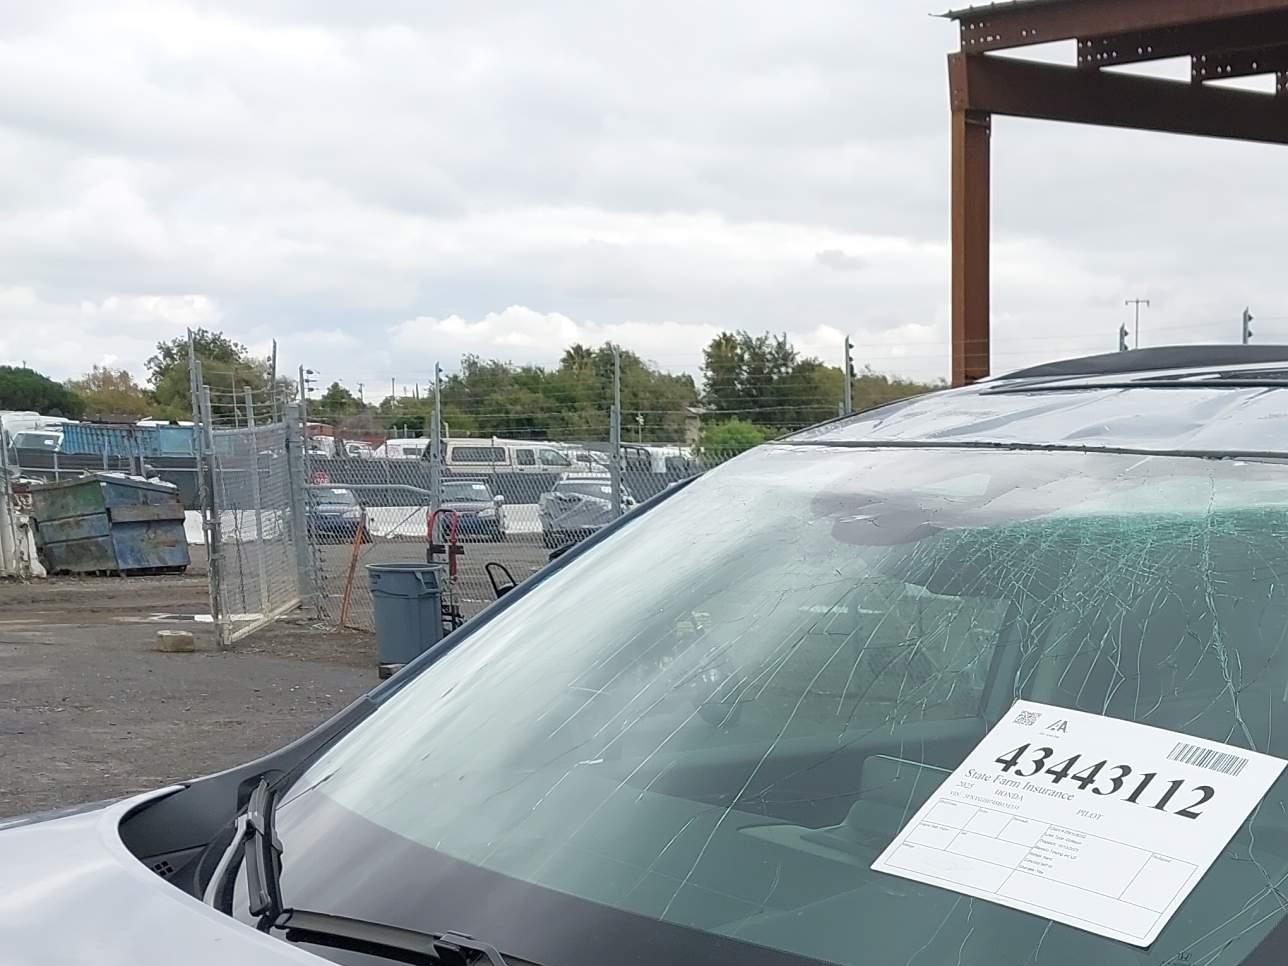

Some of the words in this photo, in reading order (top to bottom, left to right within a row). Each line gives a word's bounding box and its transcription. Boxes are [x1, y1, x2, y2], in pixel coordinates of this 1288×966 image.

[965, 768, 992, 783] State
[993, 774, 1021, 789] Farm
[1022, 781, 1076, 802] Insurance
[994, 743, 1215, 820] 43443112
[994, 788, 1025, 802] HONDA
[1076, 808, 1104, 821] PILOT
